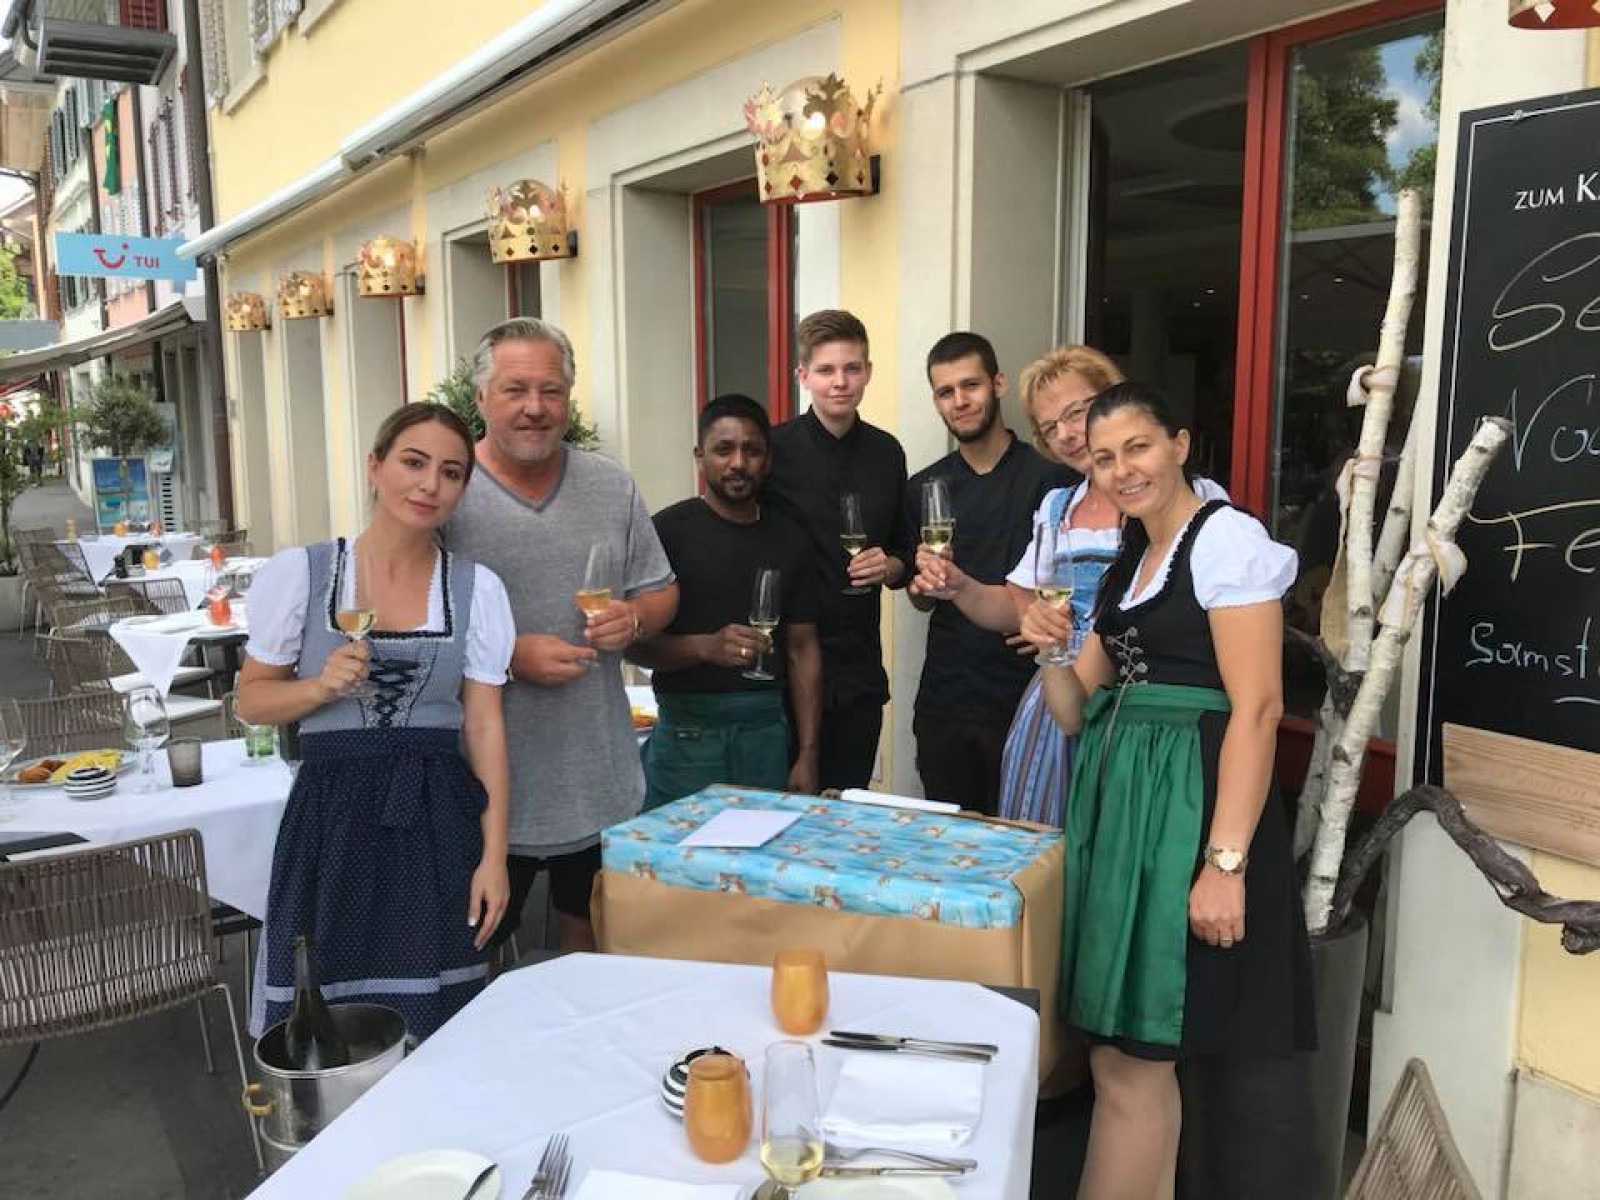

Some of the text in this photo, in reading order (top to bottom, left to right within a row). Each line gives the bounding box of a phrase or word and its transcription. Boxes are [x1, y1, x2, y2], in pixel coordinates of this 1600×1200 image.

[1514, 171, 1600, 210] ZUM K
[133, 254, 160, 269] TUI
[1465, 616, 1600, 678] Samst
